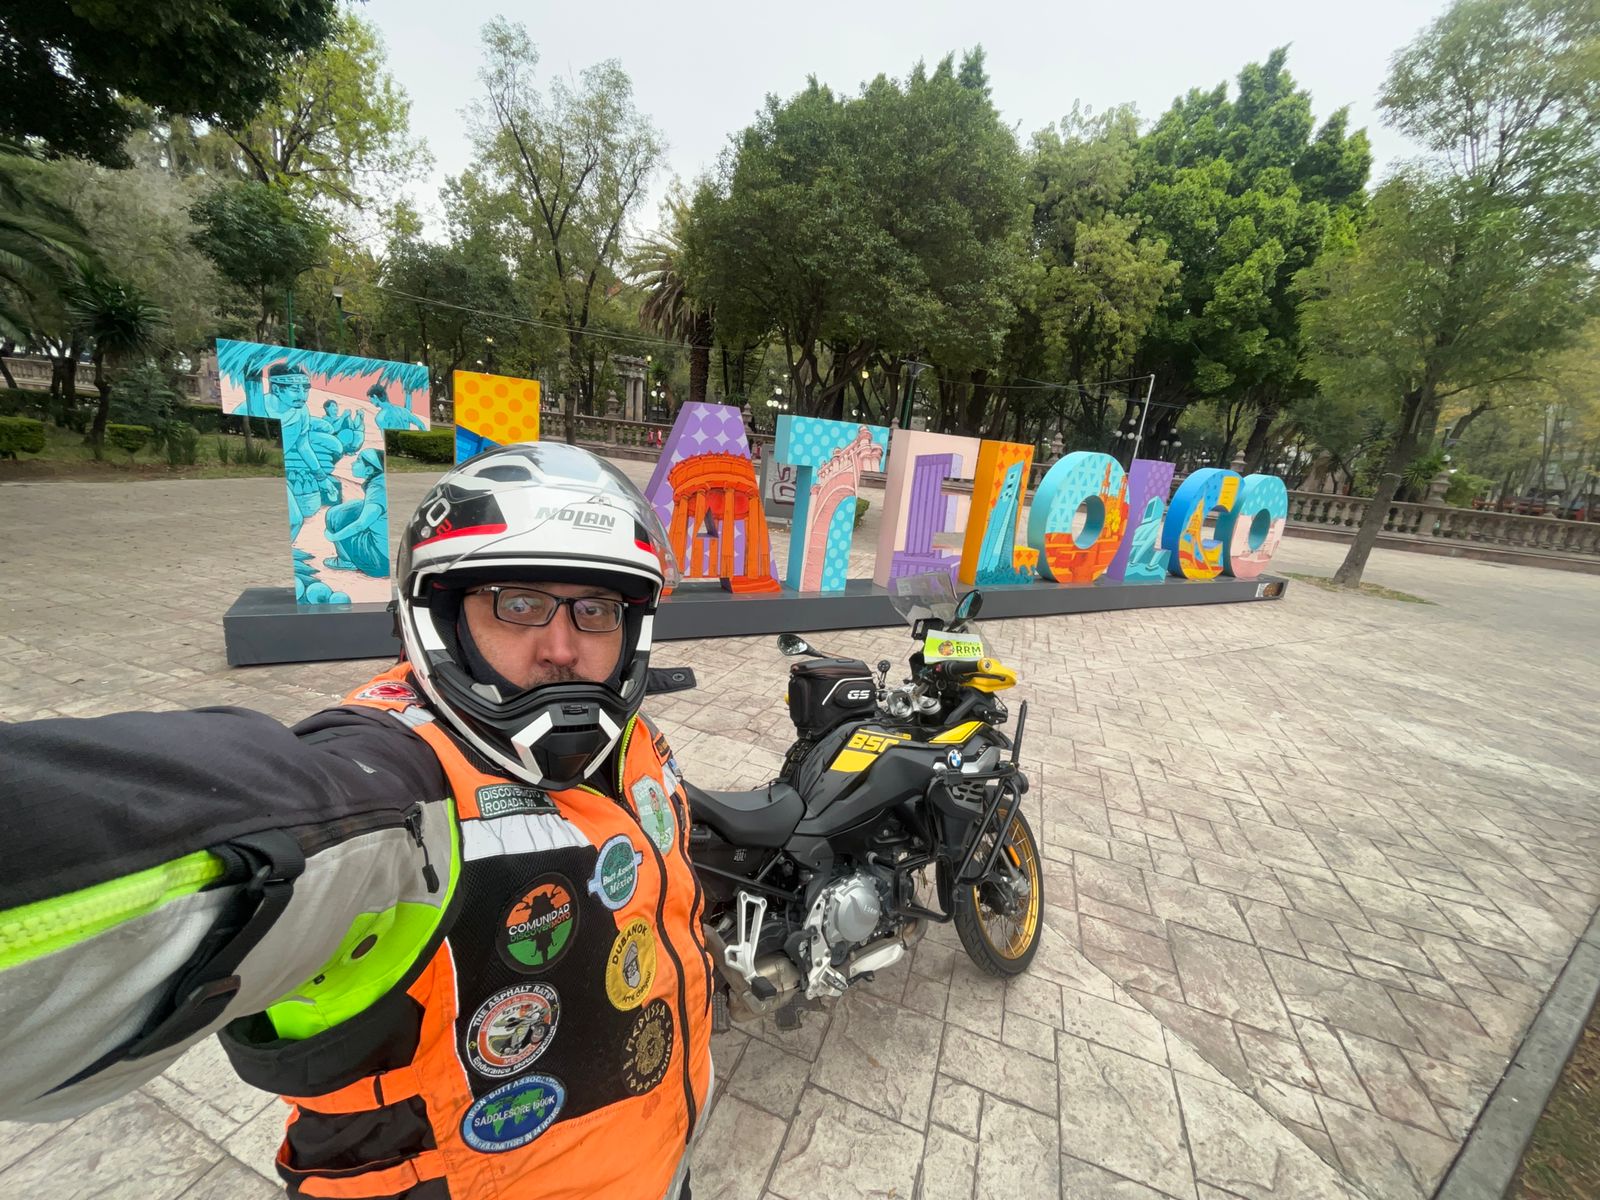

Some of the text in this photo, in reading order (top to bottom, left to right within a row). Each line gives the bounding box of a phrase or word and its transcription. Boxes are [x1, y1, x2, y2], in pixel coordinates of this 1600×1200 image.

[535, 507, 616, 533] NOLAN
[956, 645, 981, 655] RRM
[847, 689, 871, 700] GS
[508, 903, 570, 936] COMUNIDAD
[611, 923, 648, 966] DUBANOK
[472, 1008, 489, 1027] THE
[488, 985, 533, 1011] ASPHALT
[474, 1102, 532, 1128] SADDLESORE
